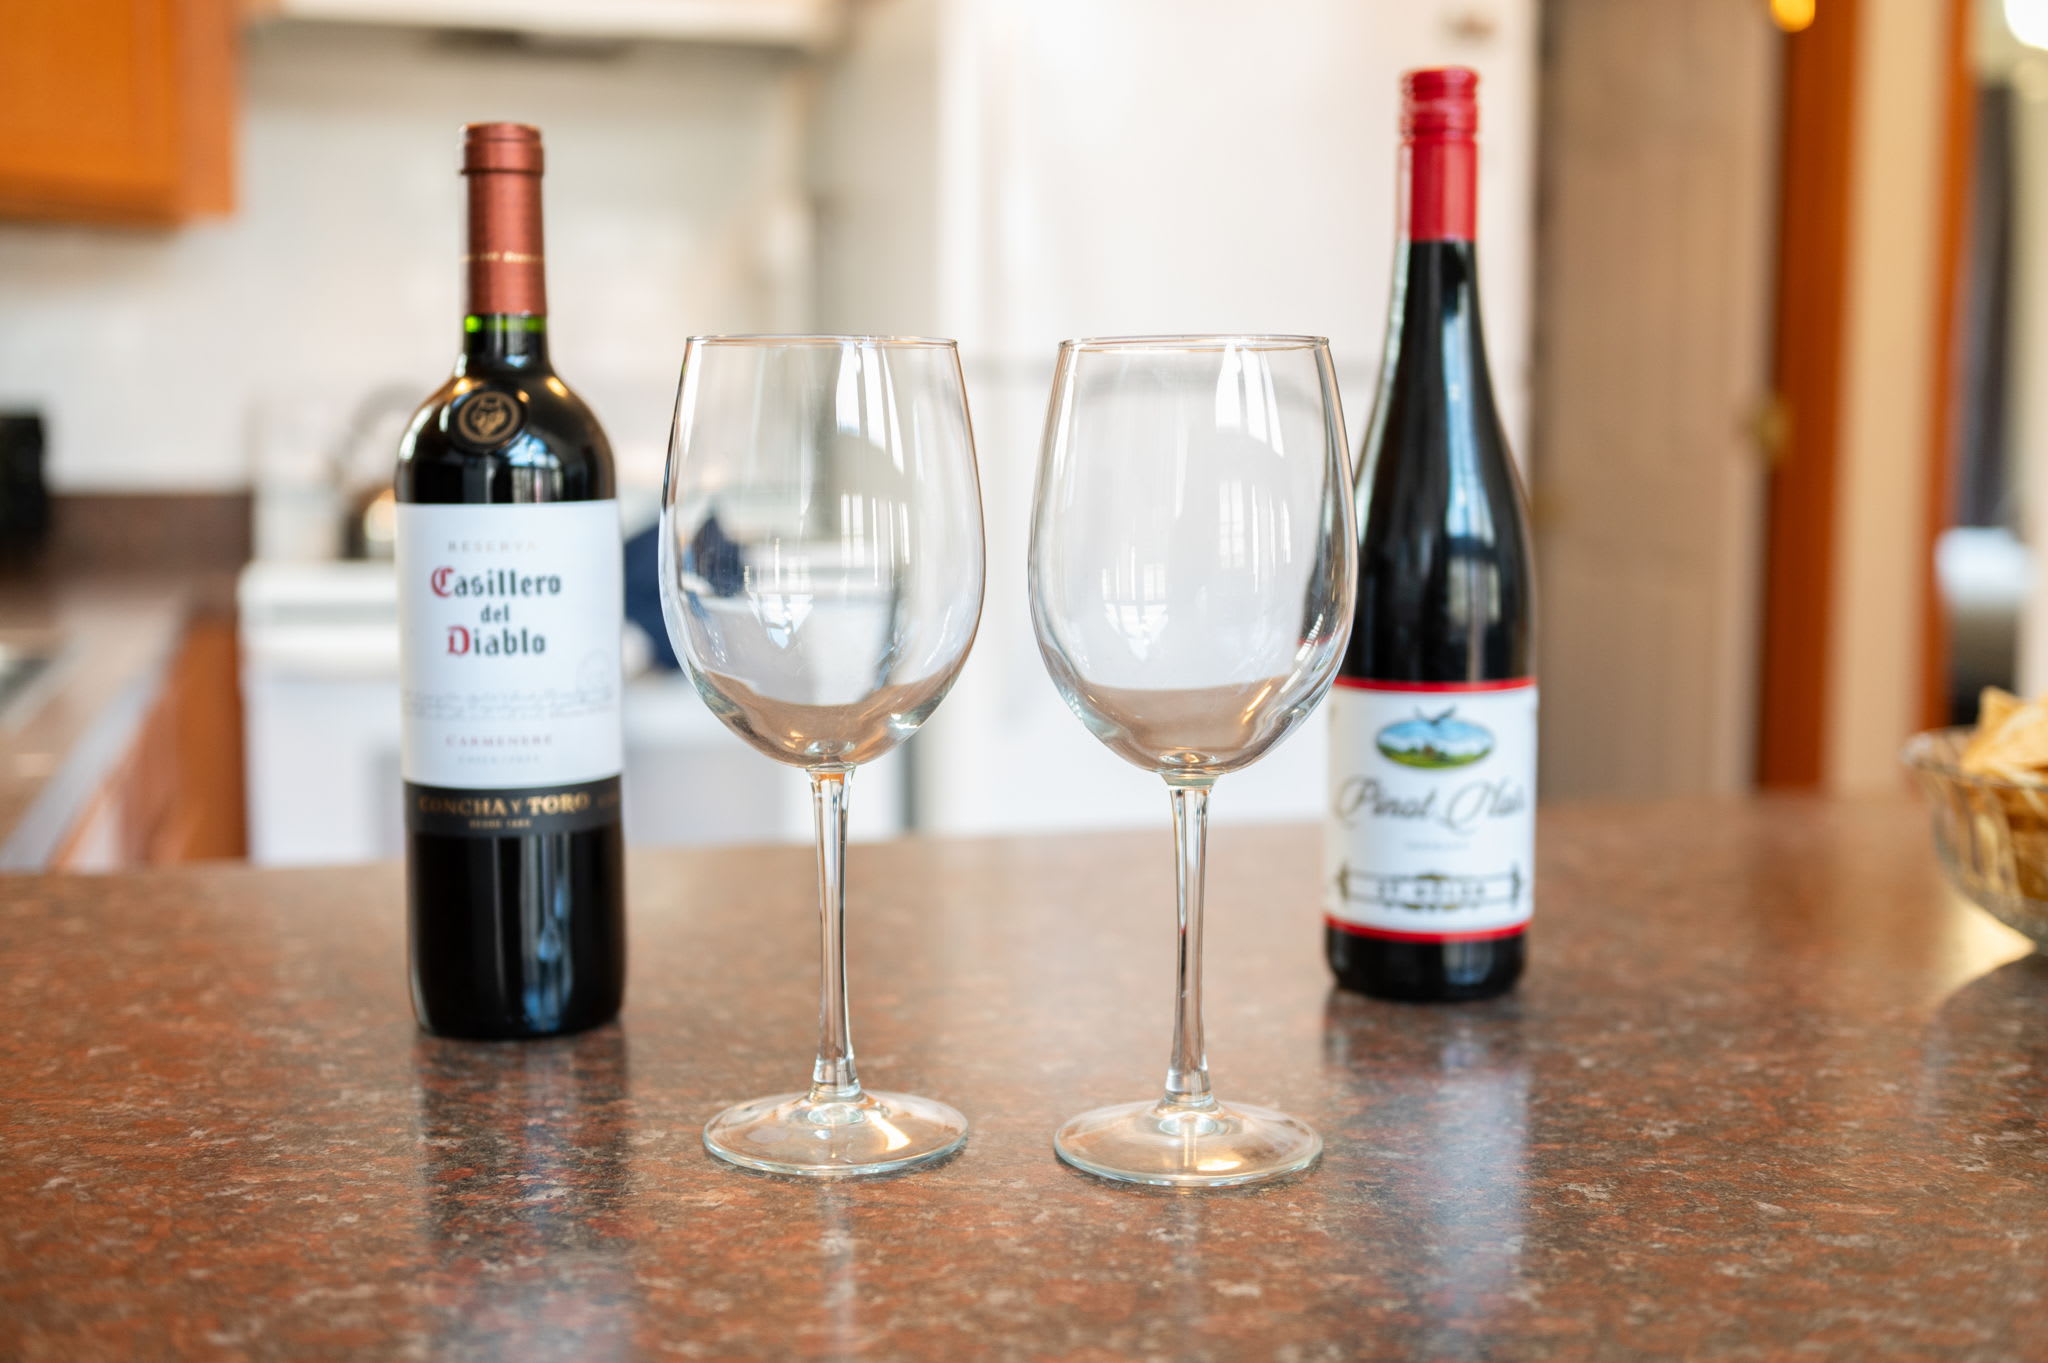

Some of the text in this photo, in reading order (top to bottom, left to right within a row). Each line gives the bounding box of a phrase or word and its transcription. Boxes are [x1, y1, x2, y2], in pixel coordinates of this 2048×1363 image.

[430, 566, 562, 598] Casillero
[480, 603, 510, 624] del
[446, 625, 547, 656] Diablo
[418, 793, 508, 817] CONCHA
[511, 797, 523, 814] Y
[526, 791, 591, 817] TORO
[1334, 774, 1438, 831] Pinot
